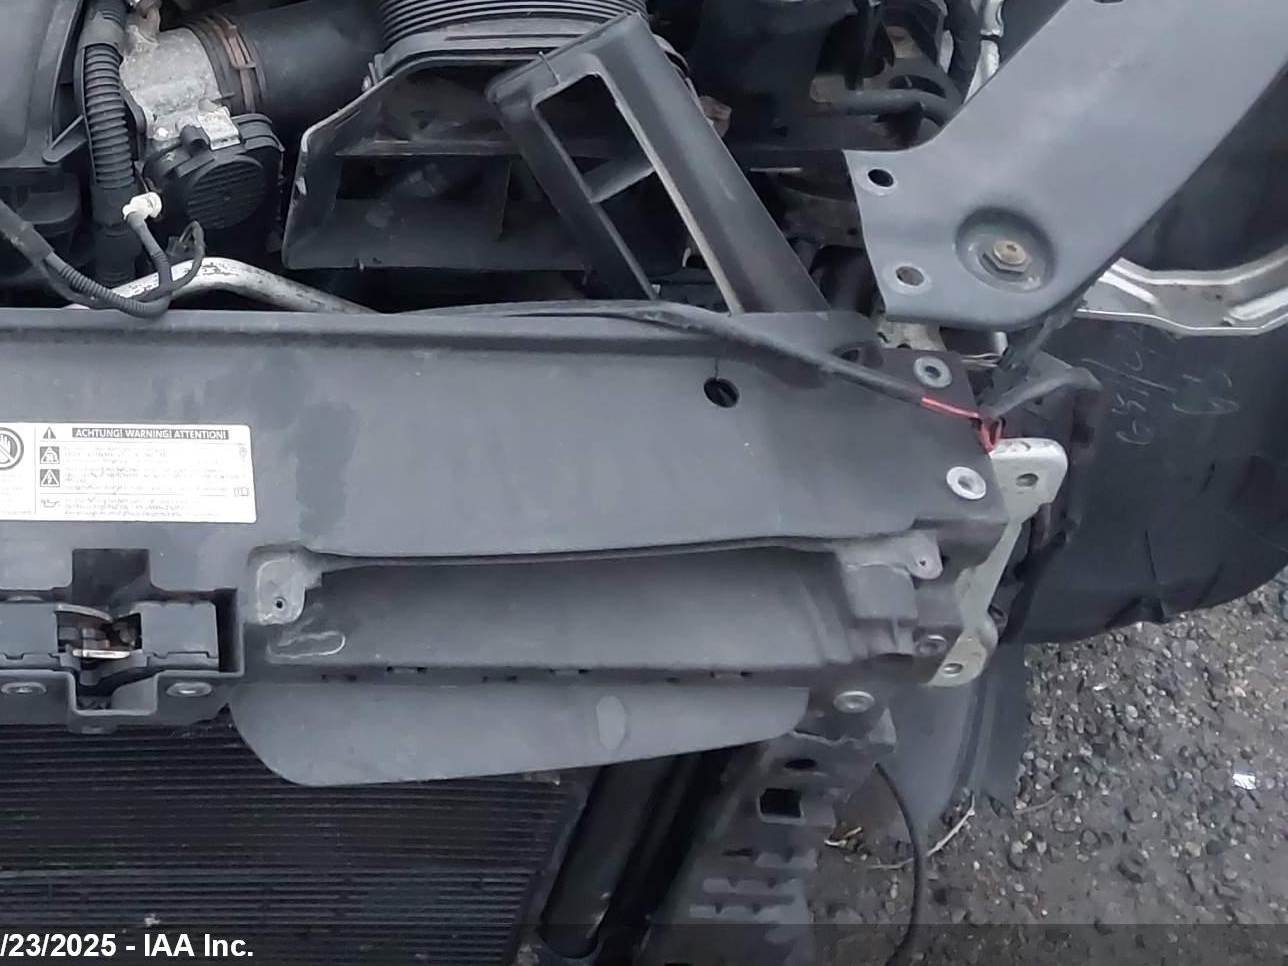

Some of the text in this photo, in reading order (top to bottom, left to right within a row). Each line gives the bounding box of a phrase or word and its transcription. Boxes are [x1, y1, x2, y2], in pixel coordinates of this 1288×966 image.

[76, 428, 226, 440] ACHTUNG! WARNING! ATTENTION!
